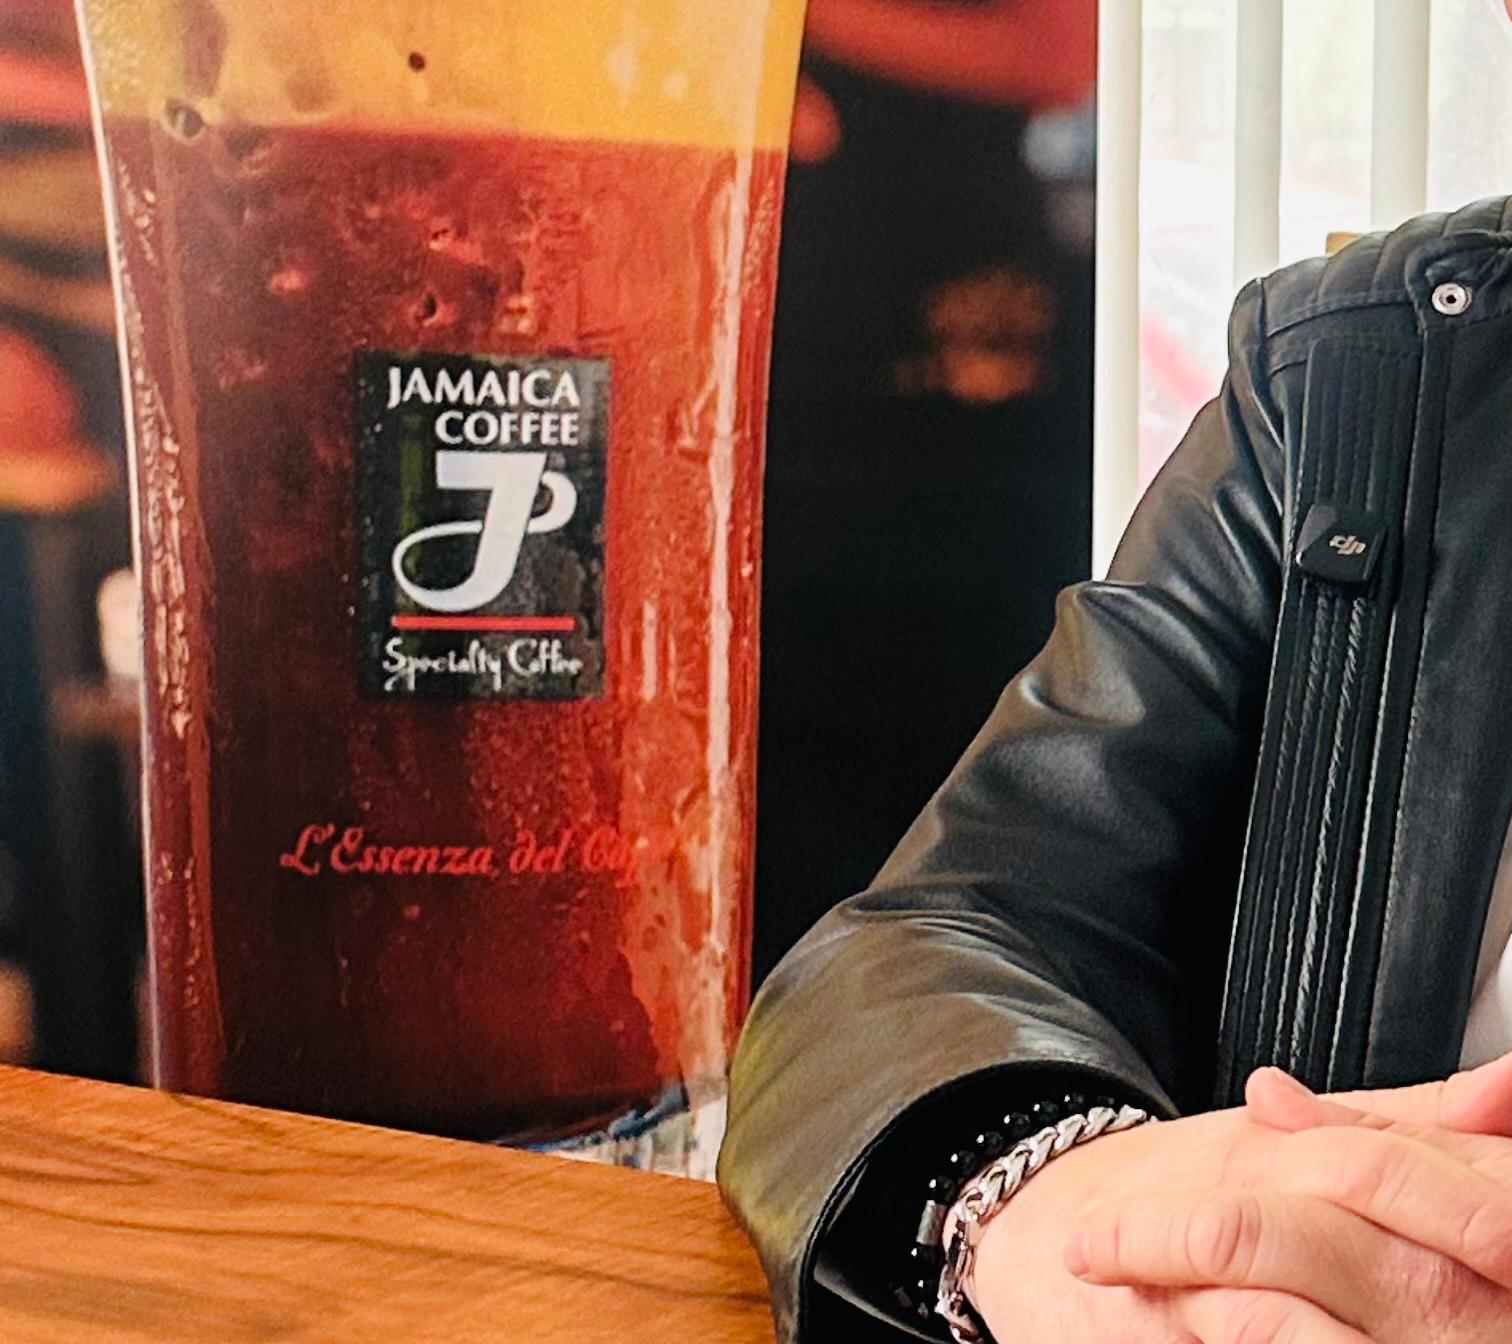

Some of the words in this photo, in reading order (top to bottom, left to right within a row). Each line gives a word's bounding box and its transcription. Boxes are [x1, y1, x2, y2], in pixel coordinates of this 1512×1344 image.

[387, 367, 580, 409] JAMAICA
[435, 410, 580, 446] COFFEE
[382, 637, 501, 692] Specialty
